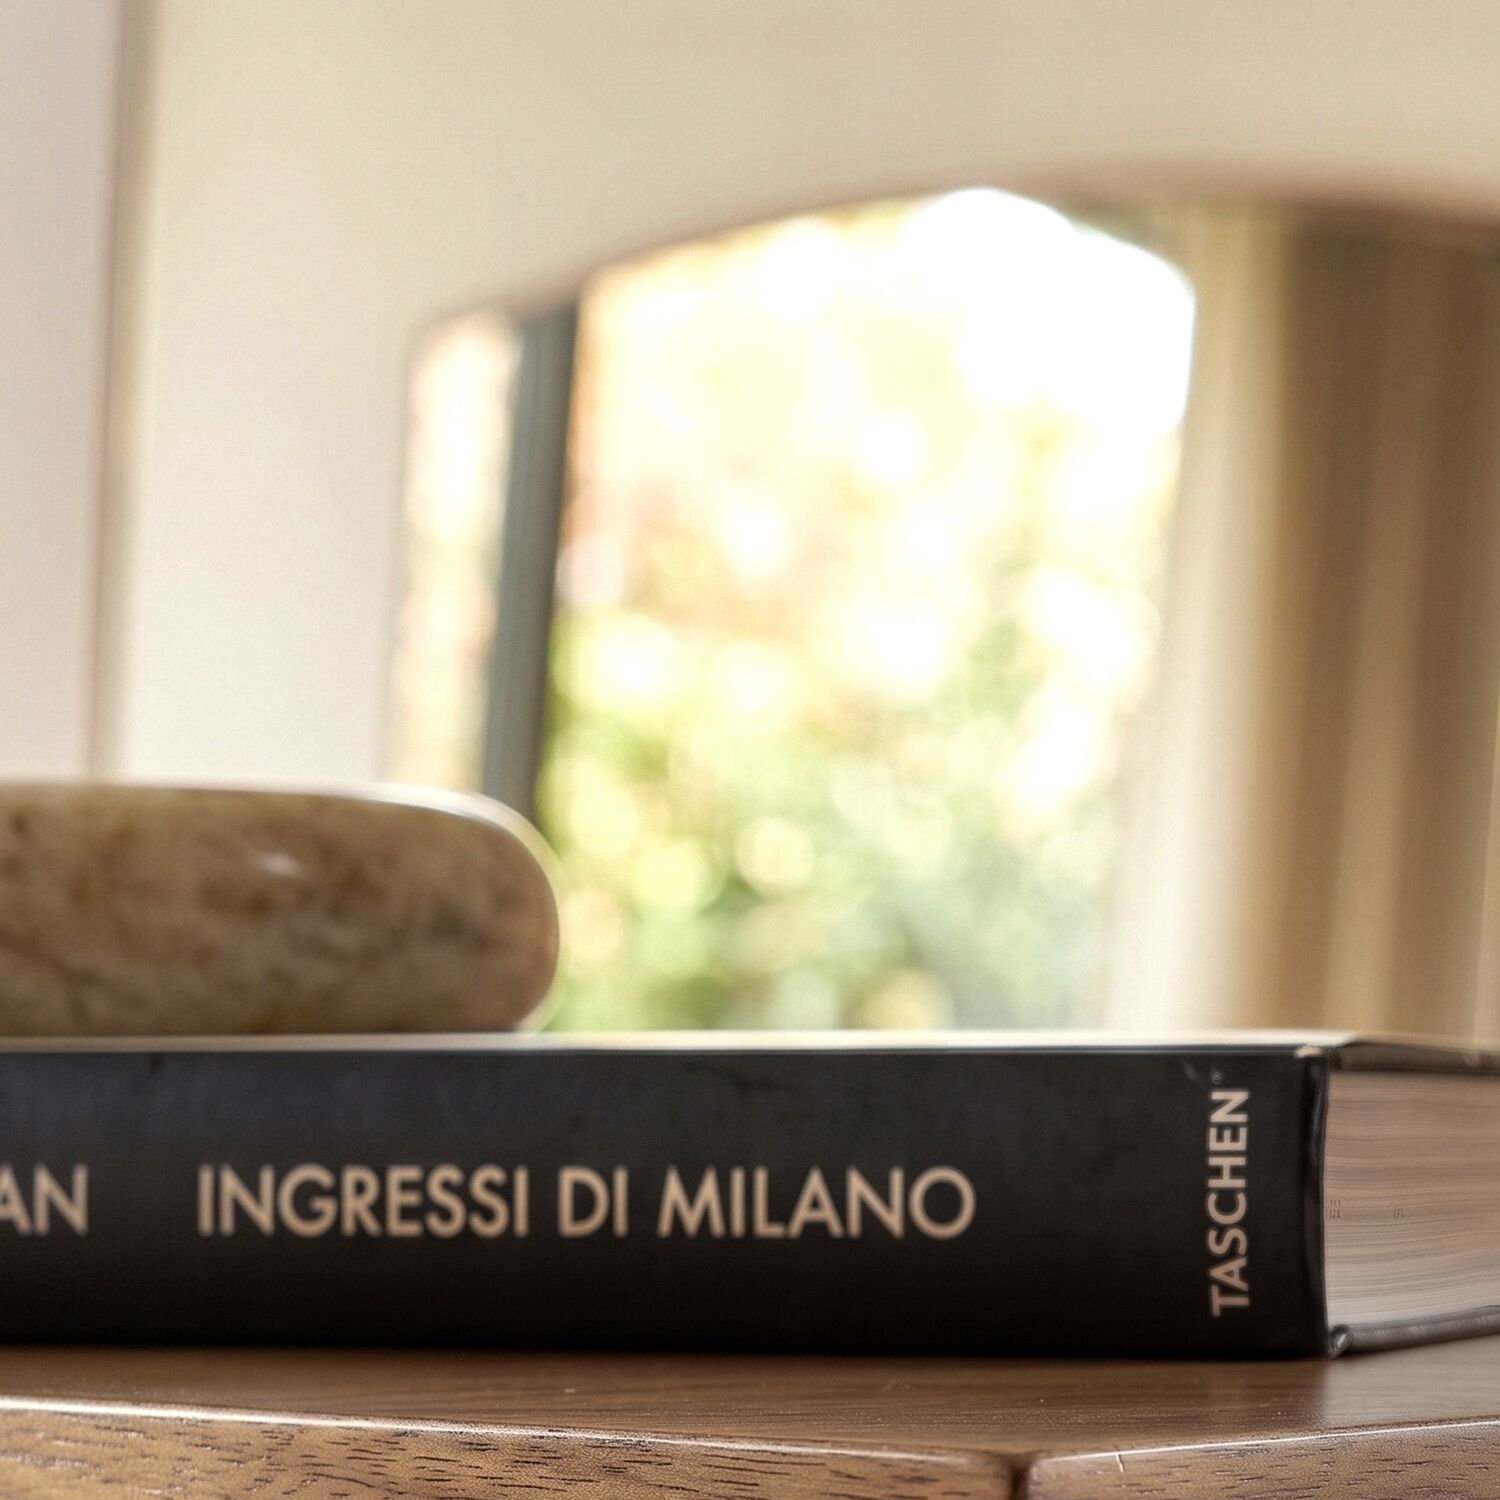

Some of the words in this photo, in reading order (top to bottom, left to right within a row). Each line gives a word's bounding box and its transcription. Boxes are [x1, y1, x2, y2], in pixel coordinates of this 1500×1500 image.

[197, 1163, 529, 1237] INGRESSI
[558, 1165, 629, 1236] DI
[658, 1166, 976, 1238] MILANO
[1207, 1089, 1250, 1318] TASCHEN
